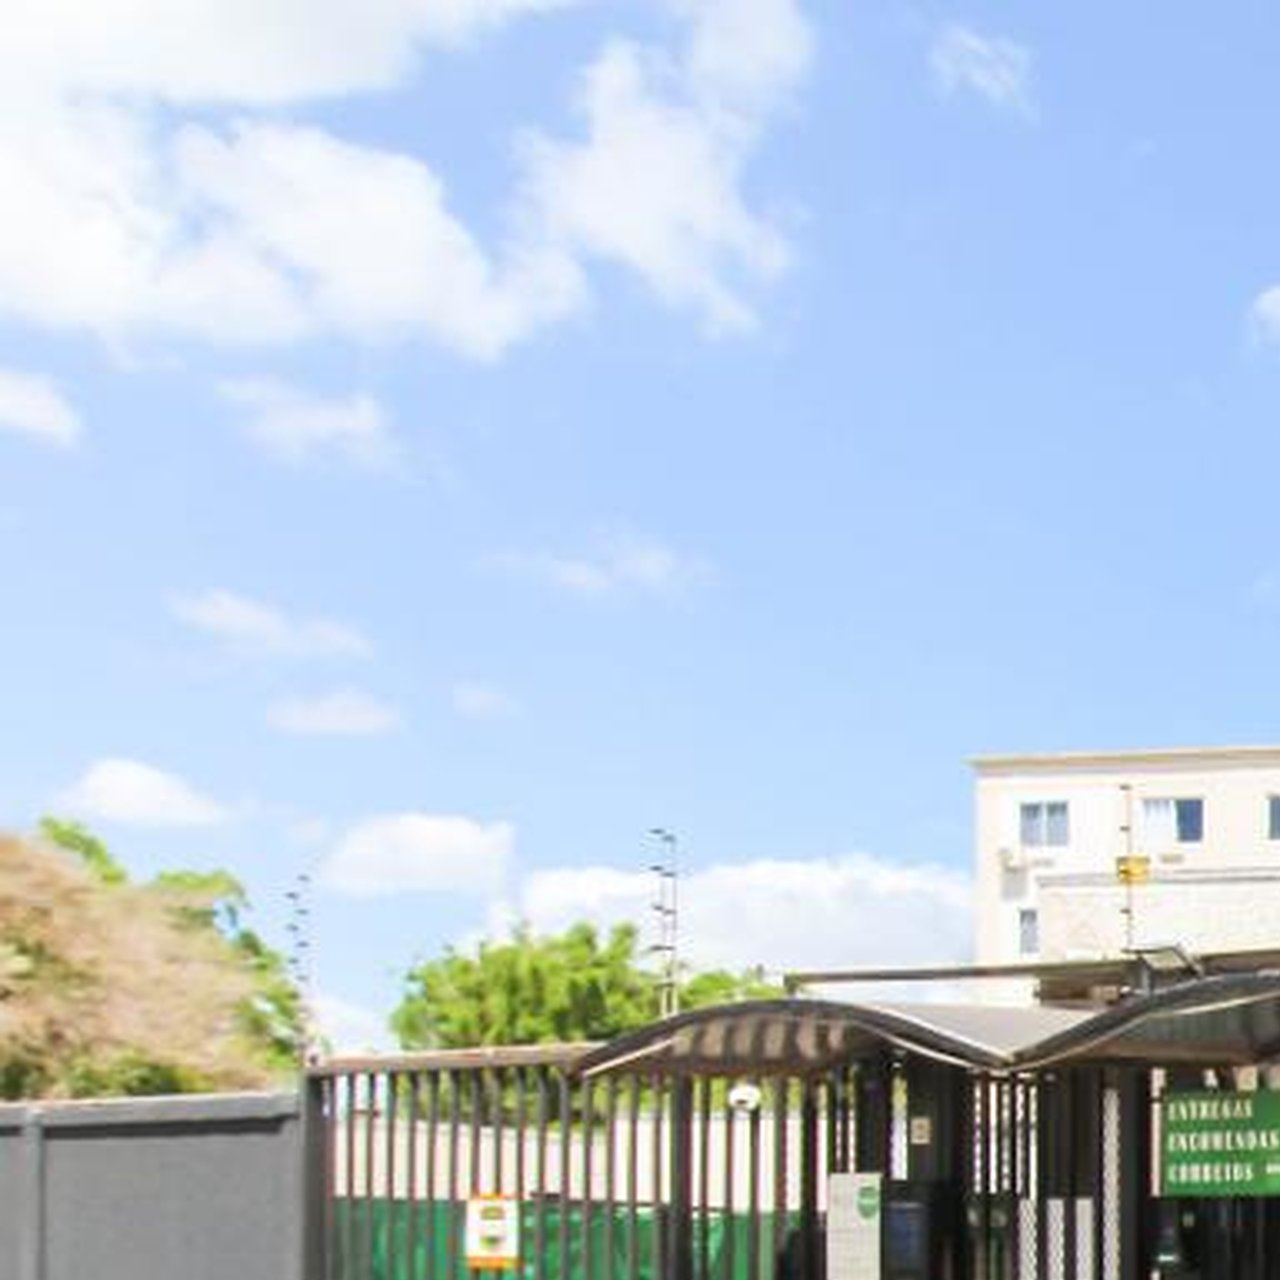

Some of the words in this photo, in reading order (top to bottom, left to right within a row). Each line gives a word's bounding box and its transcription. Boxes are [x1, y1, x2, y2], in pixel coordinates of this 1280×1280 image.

[1168, 1099, 1253, 1121] ENTREGAS
[1168, 1130, 1280, 1152] ENCOMENDAS
[1168, 1162, 1254, 1183] CORREIOS
